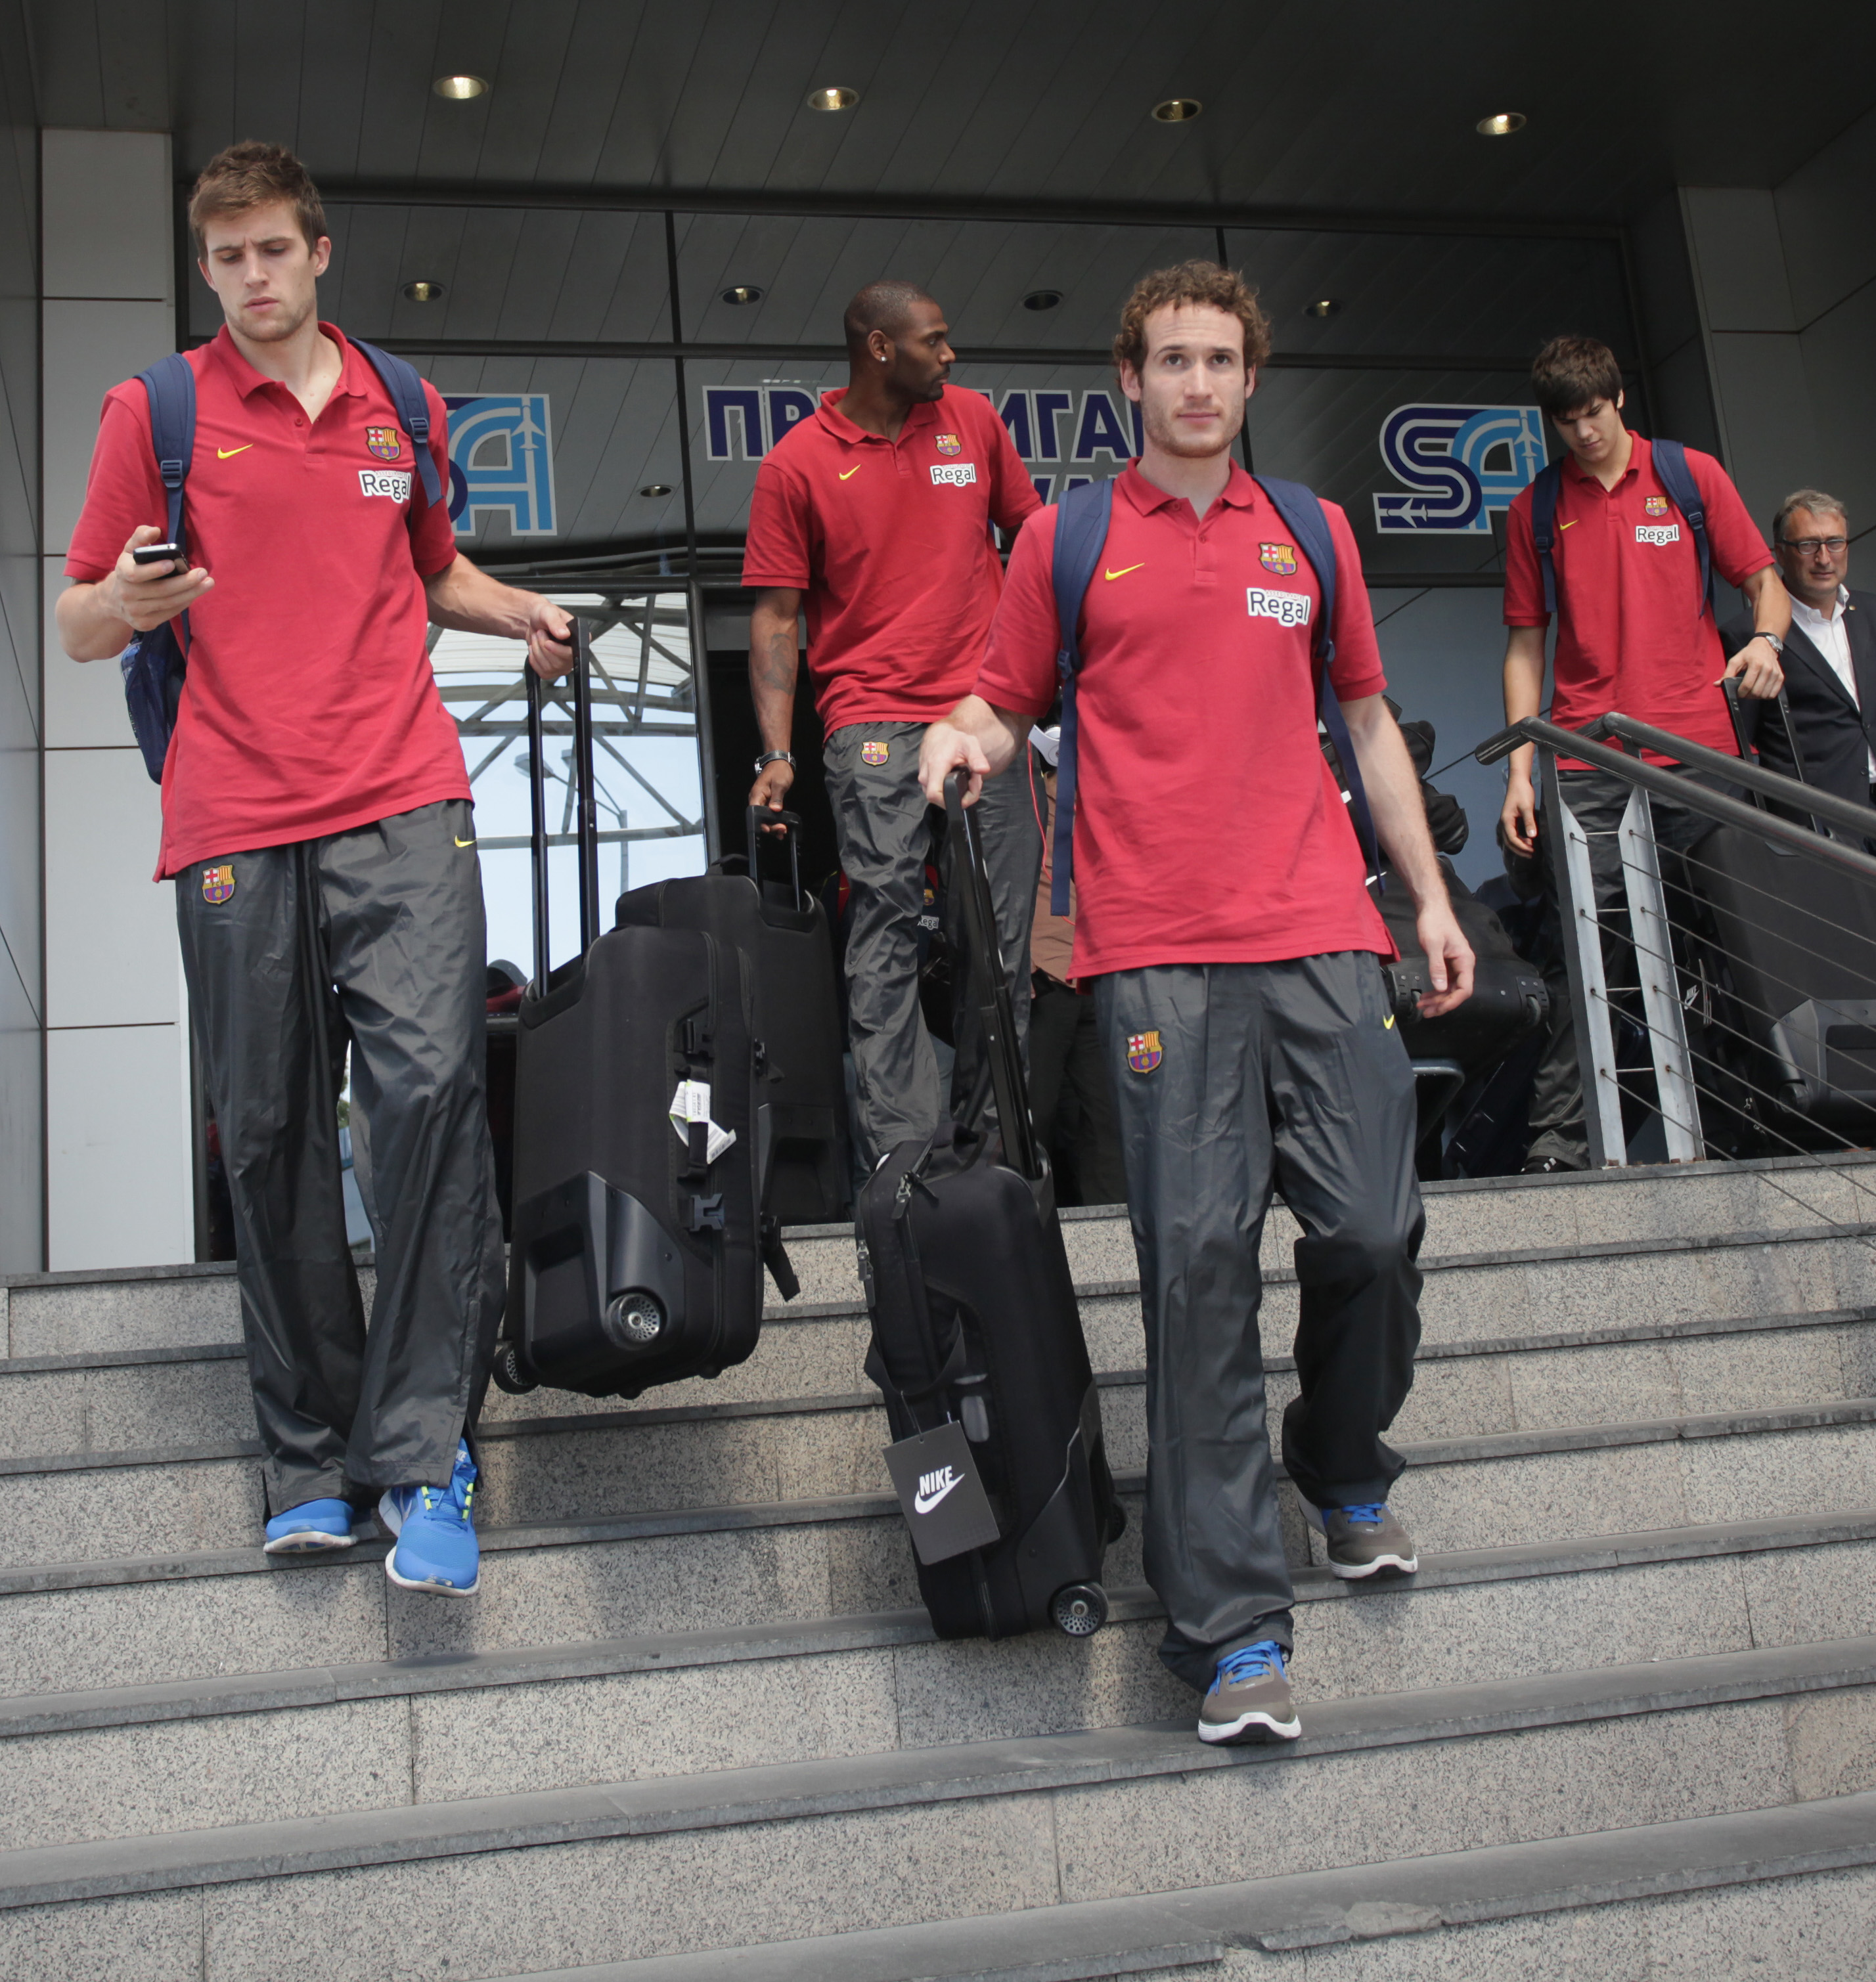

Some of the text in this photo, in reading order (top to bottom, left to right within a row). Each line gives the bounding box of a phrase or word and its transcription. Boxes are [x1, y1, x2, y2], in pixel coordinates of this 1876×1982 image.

[361, 473, 410, 500] Regal
[932, 466, 975, 484] Regal
[1638, 526, 1677, 544] Regal
[1250, 591, 1308, 623] Regal
[920, 1465, 953, 1497] NIKE
